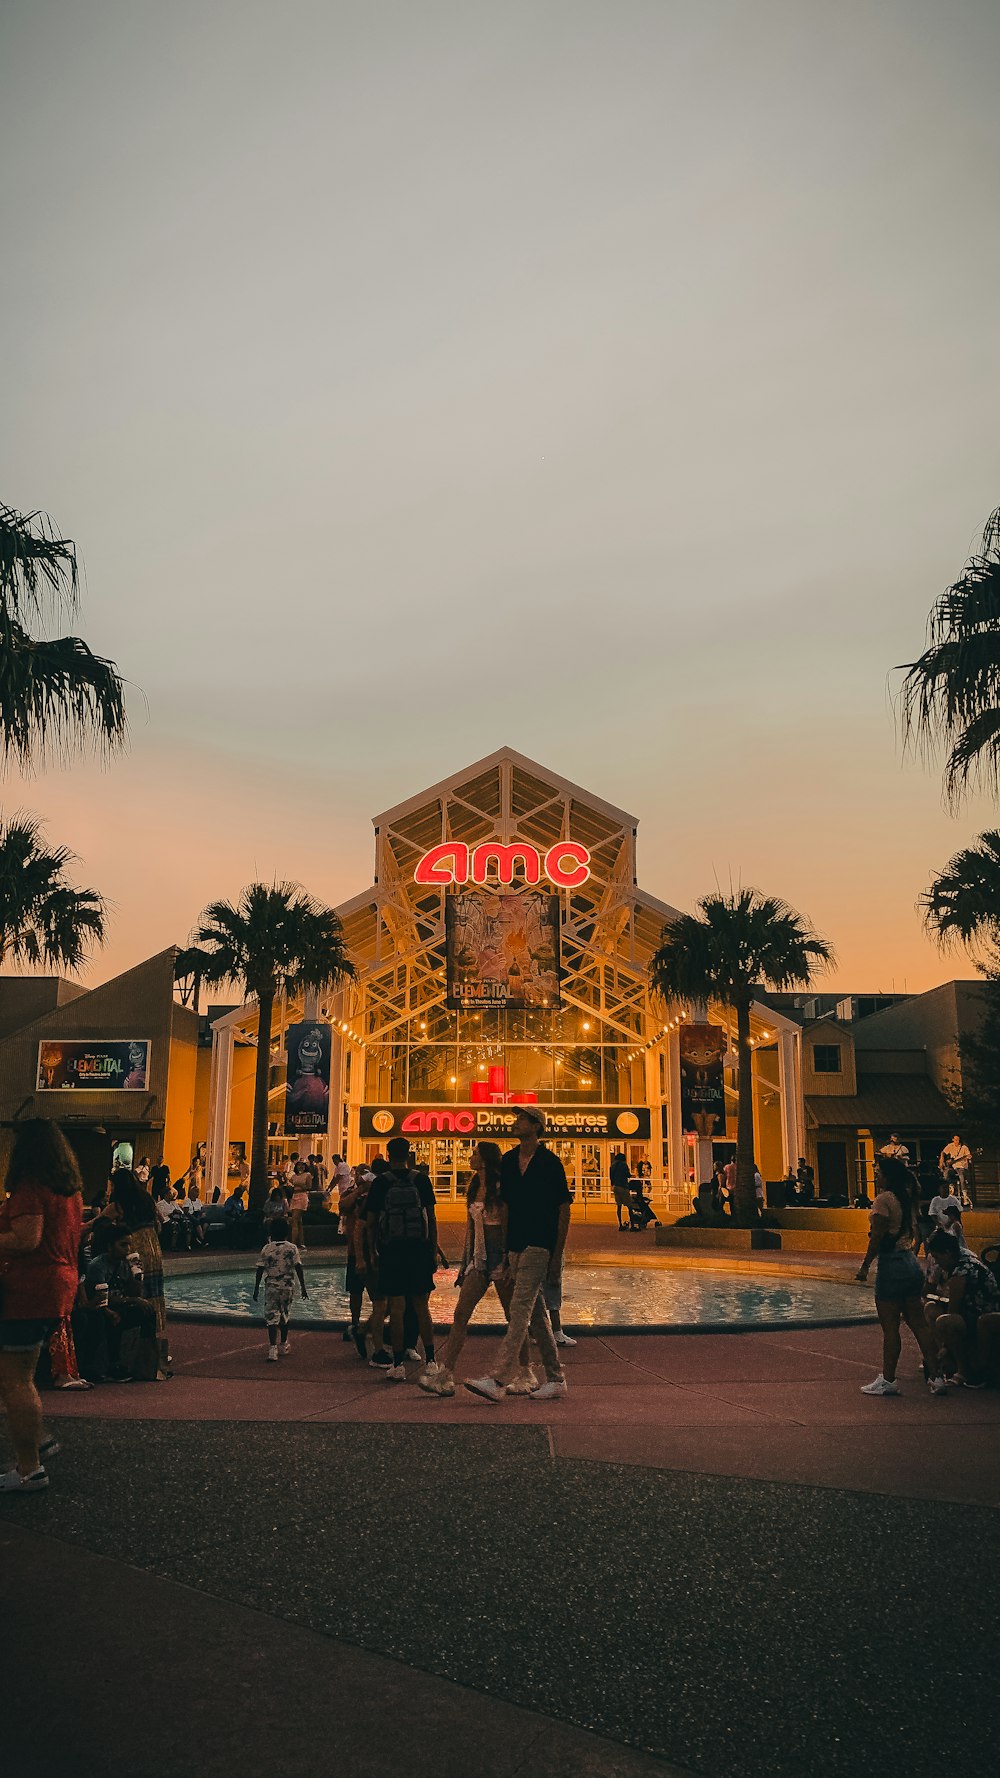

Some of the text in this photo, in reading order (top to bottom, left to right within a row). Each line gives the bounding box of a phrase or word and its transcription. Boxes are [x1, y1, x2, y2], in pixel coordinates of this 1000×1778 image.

[453, 982, 514, 999] ELEMENTAL
[67, 1057, 124, 1073] ELEMENTAL
[476, 1111, 518, 1126] Dine-
[544, 1111, 608, 1127] heatres
